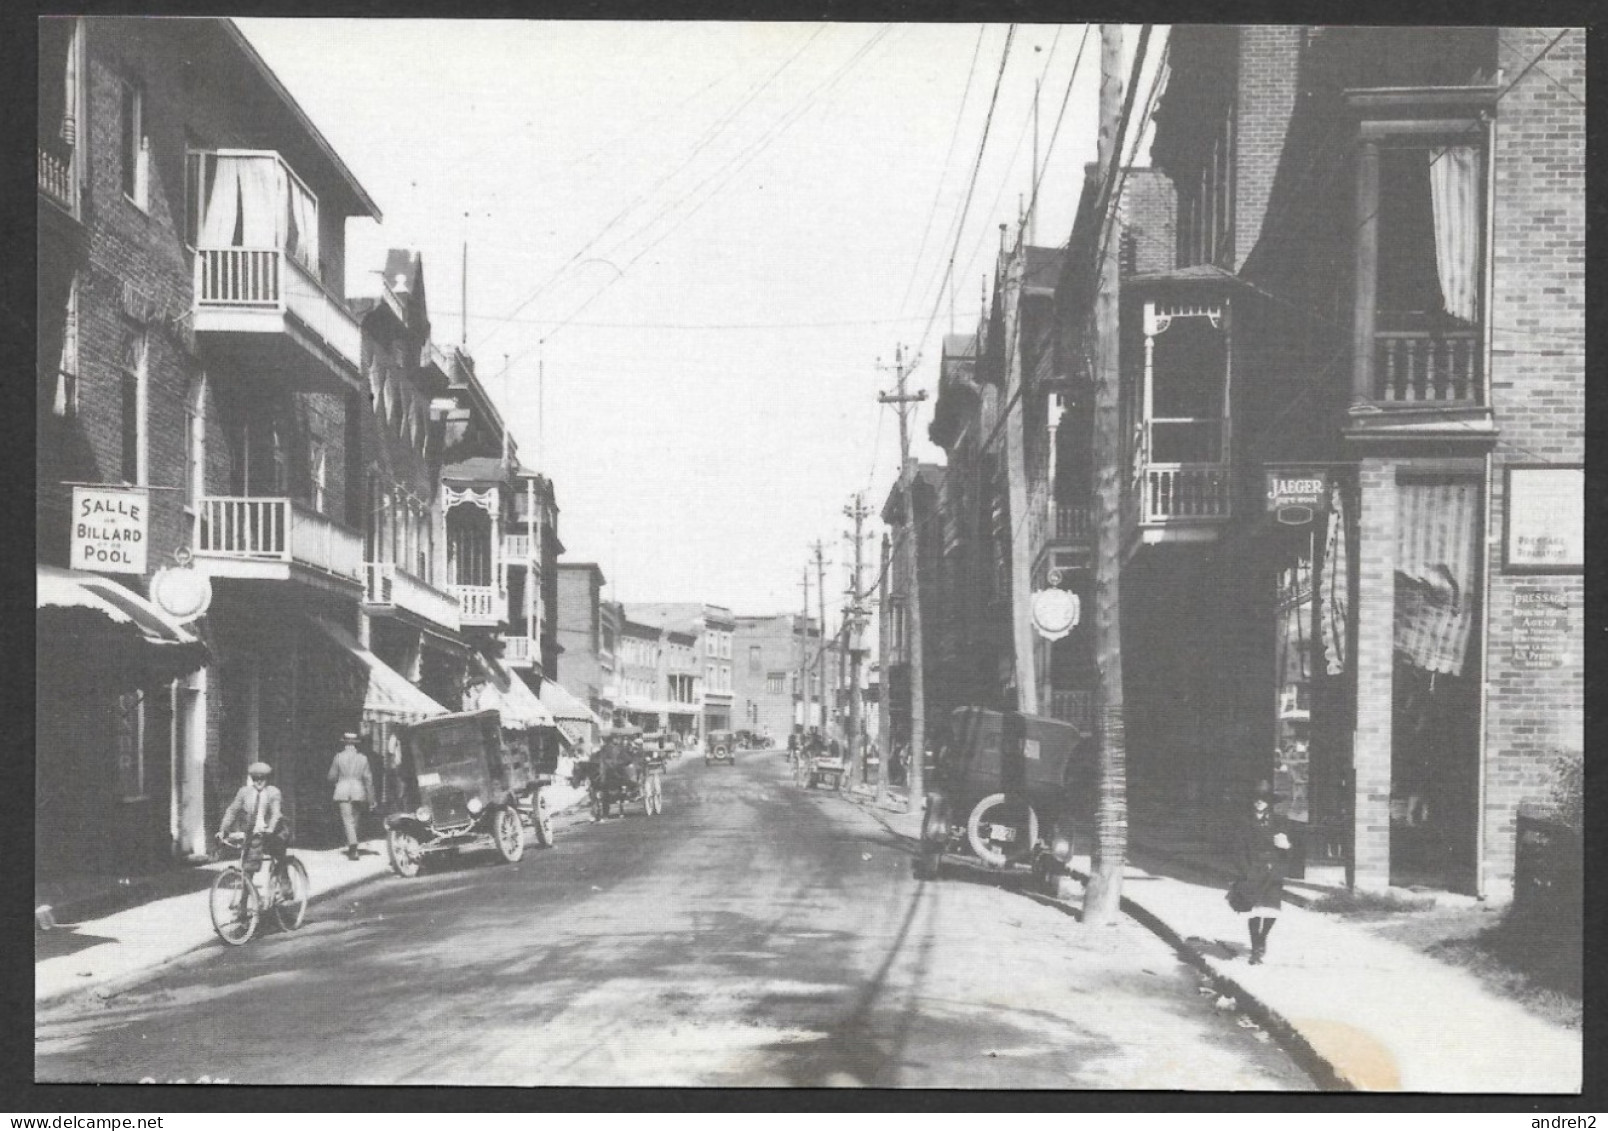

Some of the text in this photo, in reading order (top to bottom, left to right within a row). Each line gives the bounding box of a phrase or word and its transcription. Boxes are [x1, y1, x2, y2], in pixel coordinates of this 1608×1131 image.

[1267, 478, 1325, 499] JAEGER
[80, 498, 140, 522] SALLE
[77, 522, 142, 542] BILLARD
[84, 545, 131, 564] POOL
